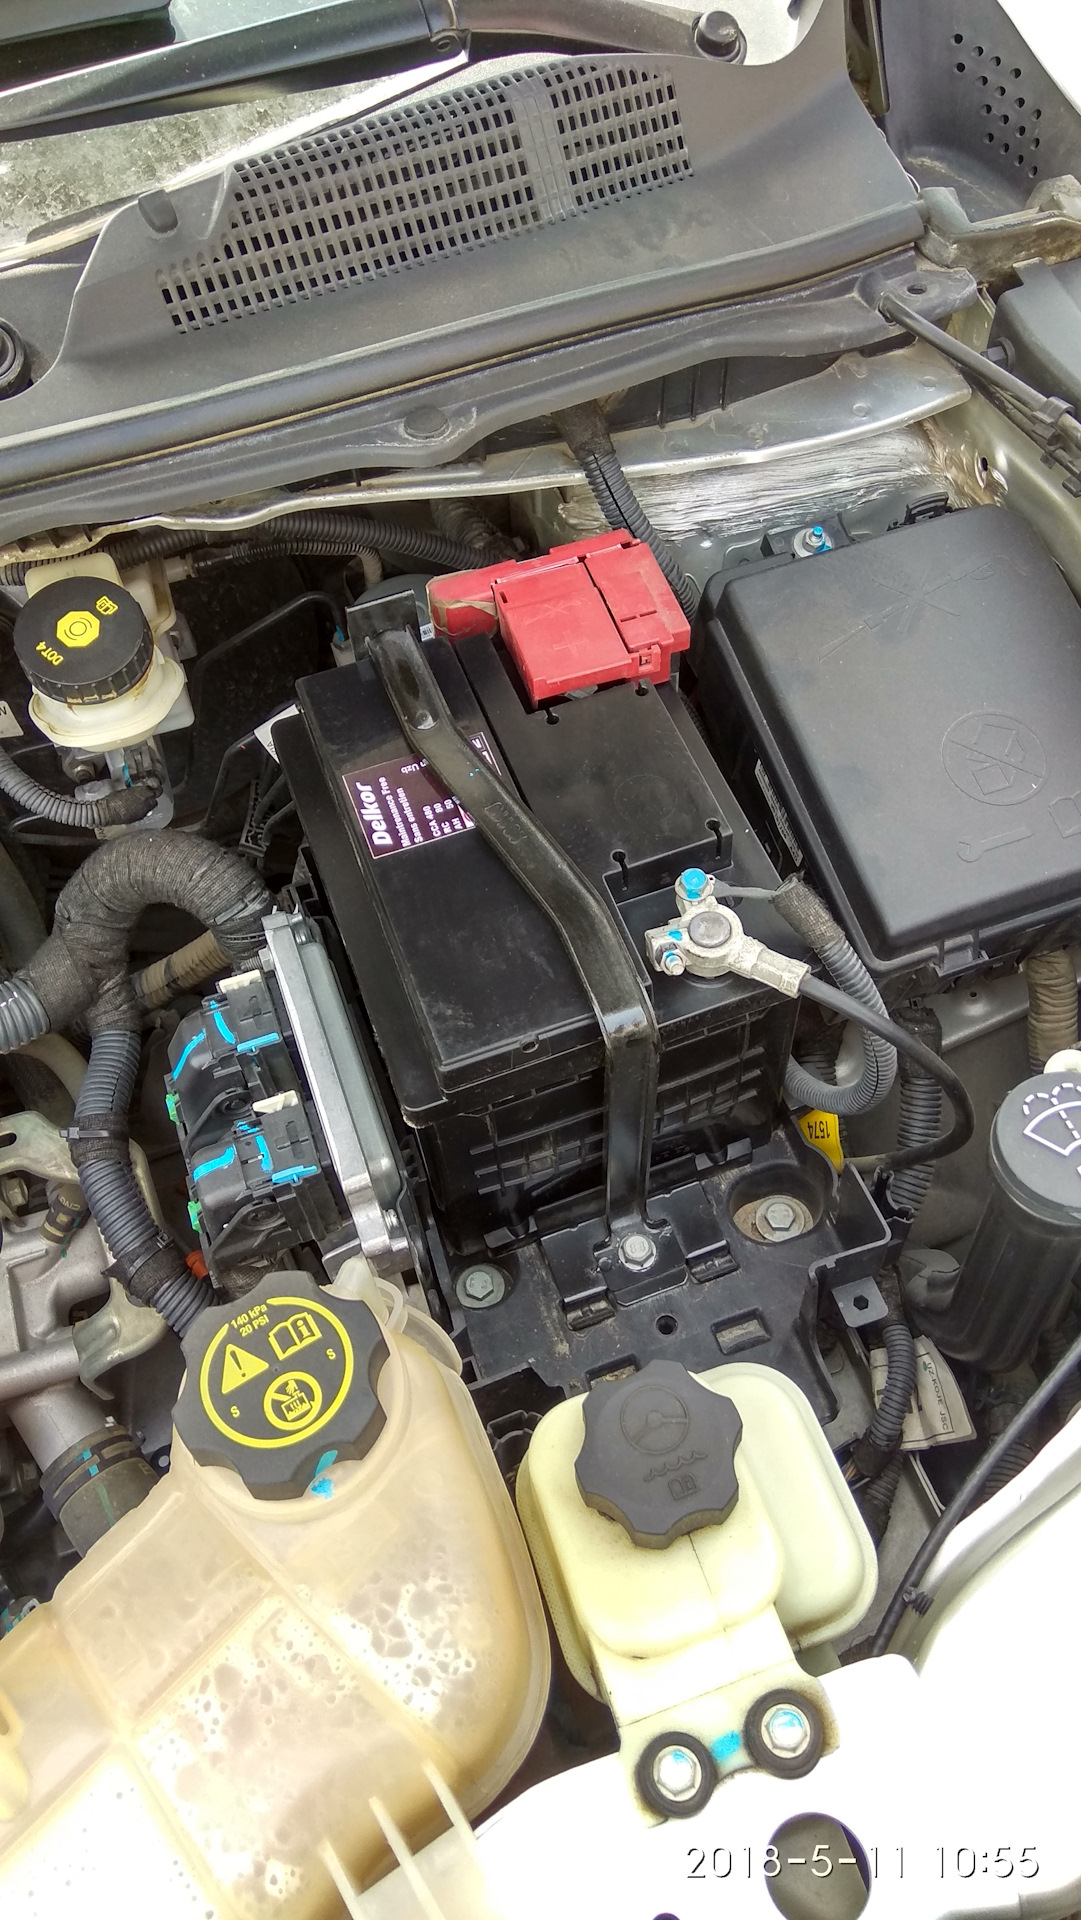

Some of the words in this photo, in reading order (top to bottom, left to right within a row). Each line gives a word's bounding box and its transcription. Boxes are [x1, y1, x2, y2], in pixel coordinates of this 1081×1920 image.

[36, 641, 64, 666] DOT4
[400, 763, 420, 774] Uzb
[378, 777, 390, 795] Free
[396, 787, 415, 822] entretien
[422, 805, 434, 820] 480
[433, 802, 444, 814] 80
[444, 798, 454, 810] 50
[355, 782, 393, 845] Delkor
[411, 822, 423, 843] Sans
[429, 819, 441, 837] CCA
[441, 821, 452, 834] RC
[451, 817, 463, 830] AH
[807, 1120, 830, 1140] 1574
[230, 1313, 249, 1329] 140
[247, 1304, 268, 1319] kPa
[239, 1323, 253, 1337] 20
[252, 1313, 269, 1330] PSI
[325, 1348, 336, 1360] S
[229, 1405, 241, 1418] S
[939, 1411, 949, 1431] JSC
